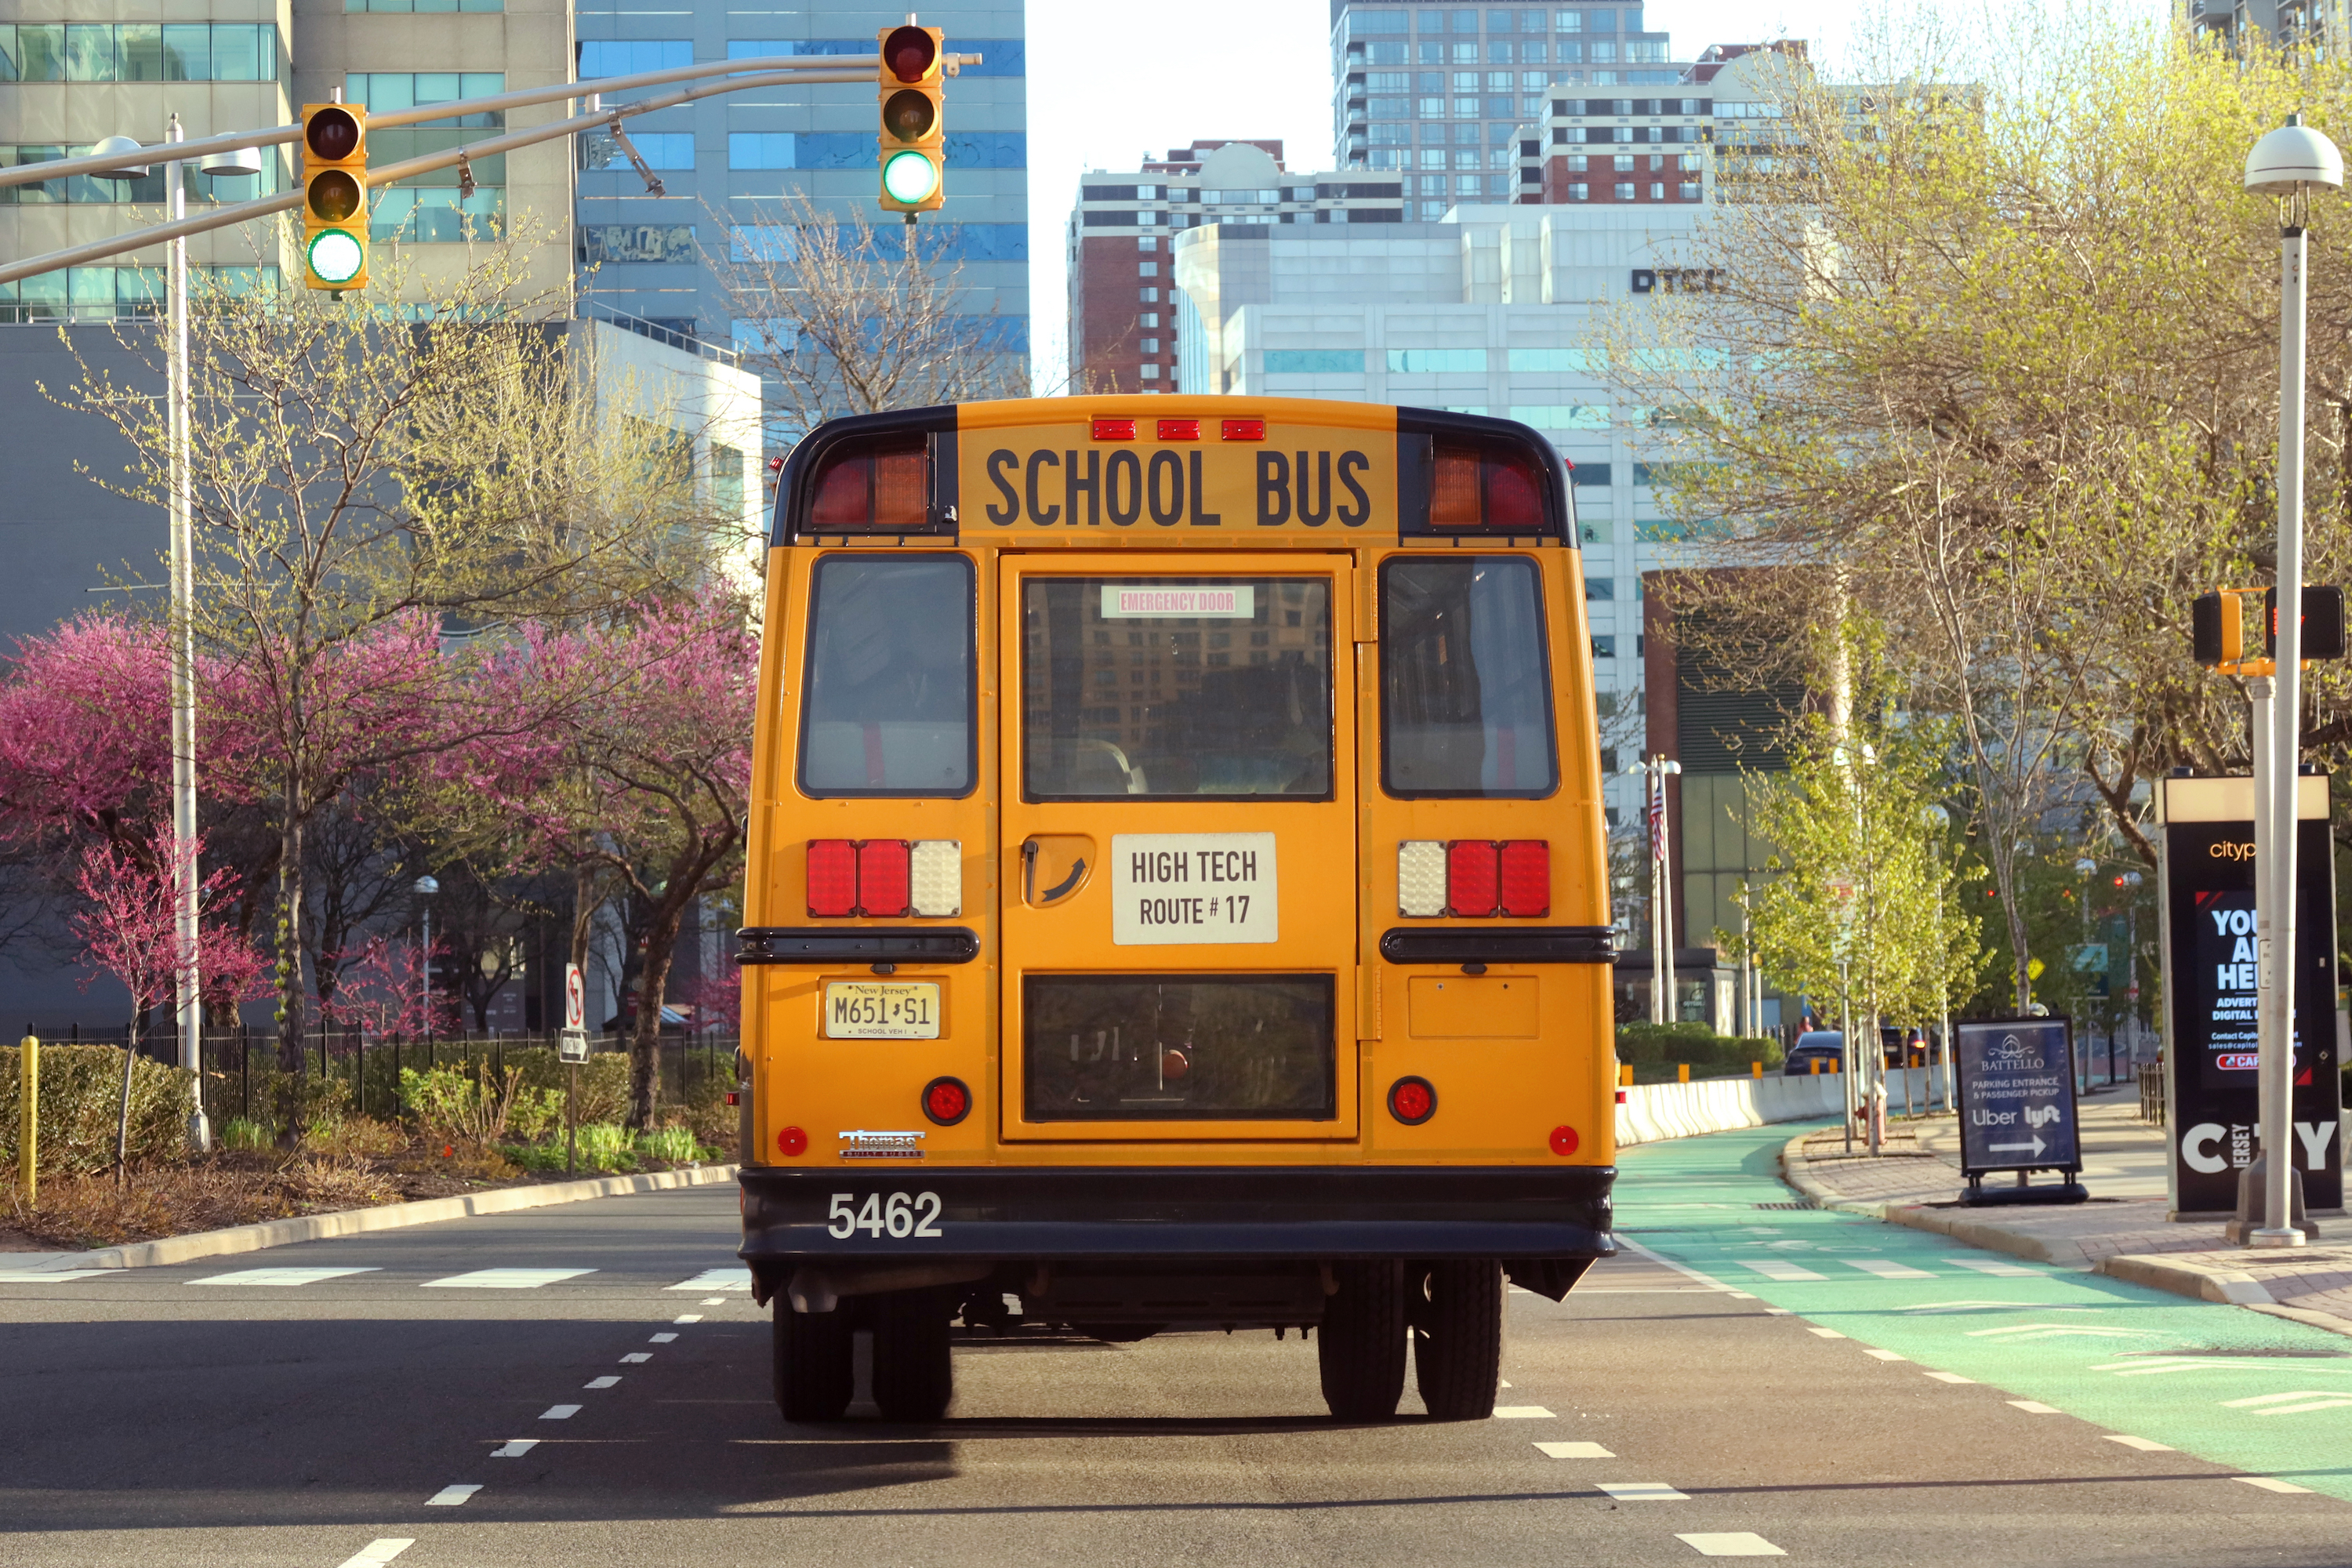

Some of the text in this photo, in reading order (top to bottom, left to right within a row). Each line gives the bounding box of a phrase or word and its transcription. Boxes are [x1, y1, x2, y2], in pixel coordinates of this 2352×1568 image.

[985, 448, 1370, 527] SCHOOL BUS
[1120, 592, 1234, 611] EMERGENCY DOOR
[2209, 840, 2256, 862] cityp
[1132, 851, 1257, 883] HIGH TECH
[1140, 898, 1203, 924] ROUTE
[1225, 895, 1250, 924] 17
[2211, 909, 2258, 936] YO
[855, 985, 911, 996] New Jersey
[835, 997, 931, 1025] M651 S1
[2216, 996, 2258, 1007] ADVERT
[2212, 1010, 2252, 1021] DIGITAL
[1981, 1058, 2045, 1072] BATTELLO
[1973, 1078, 2059, 1089] PARKING ENTRANCE
[1981, 1090, 2028, 1099] PASSENGER
[2030, 1088, 2060, 1097] PICKUP
[1973, 1105, 2060, 1129] Uber lyft
[838, 1130, 926, 1151] Thomas
[827, 1191, 942, 1240] 5462
